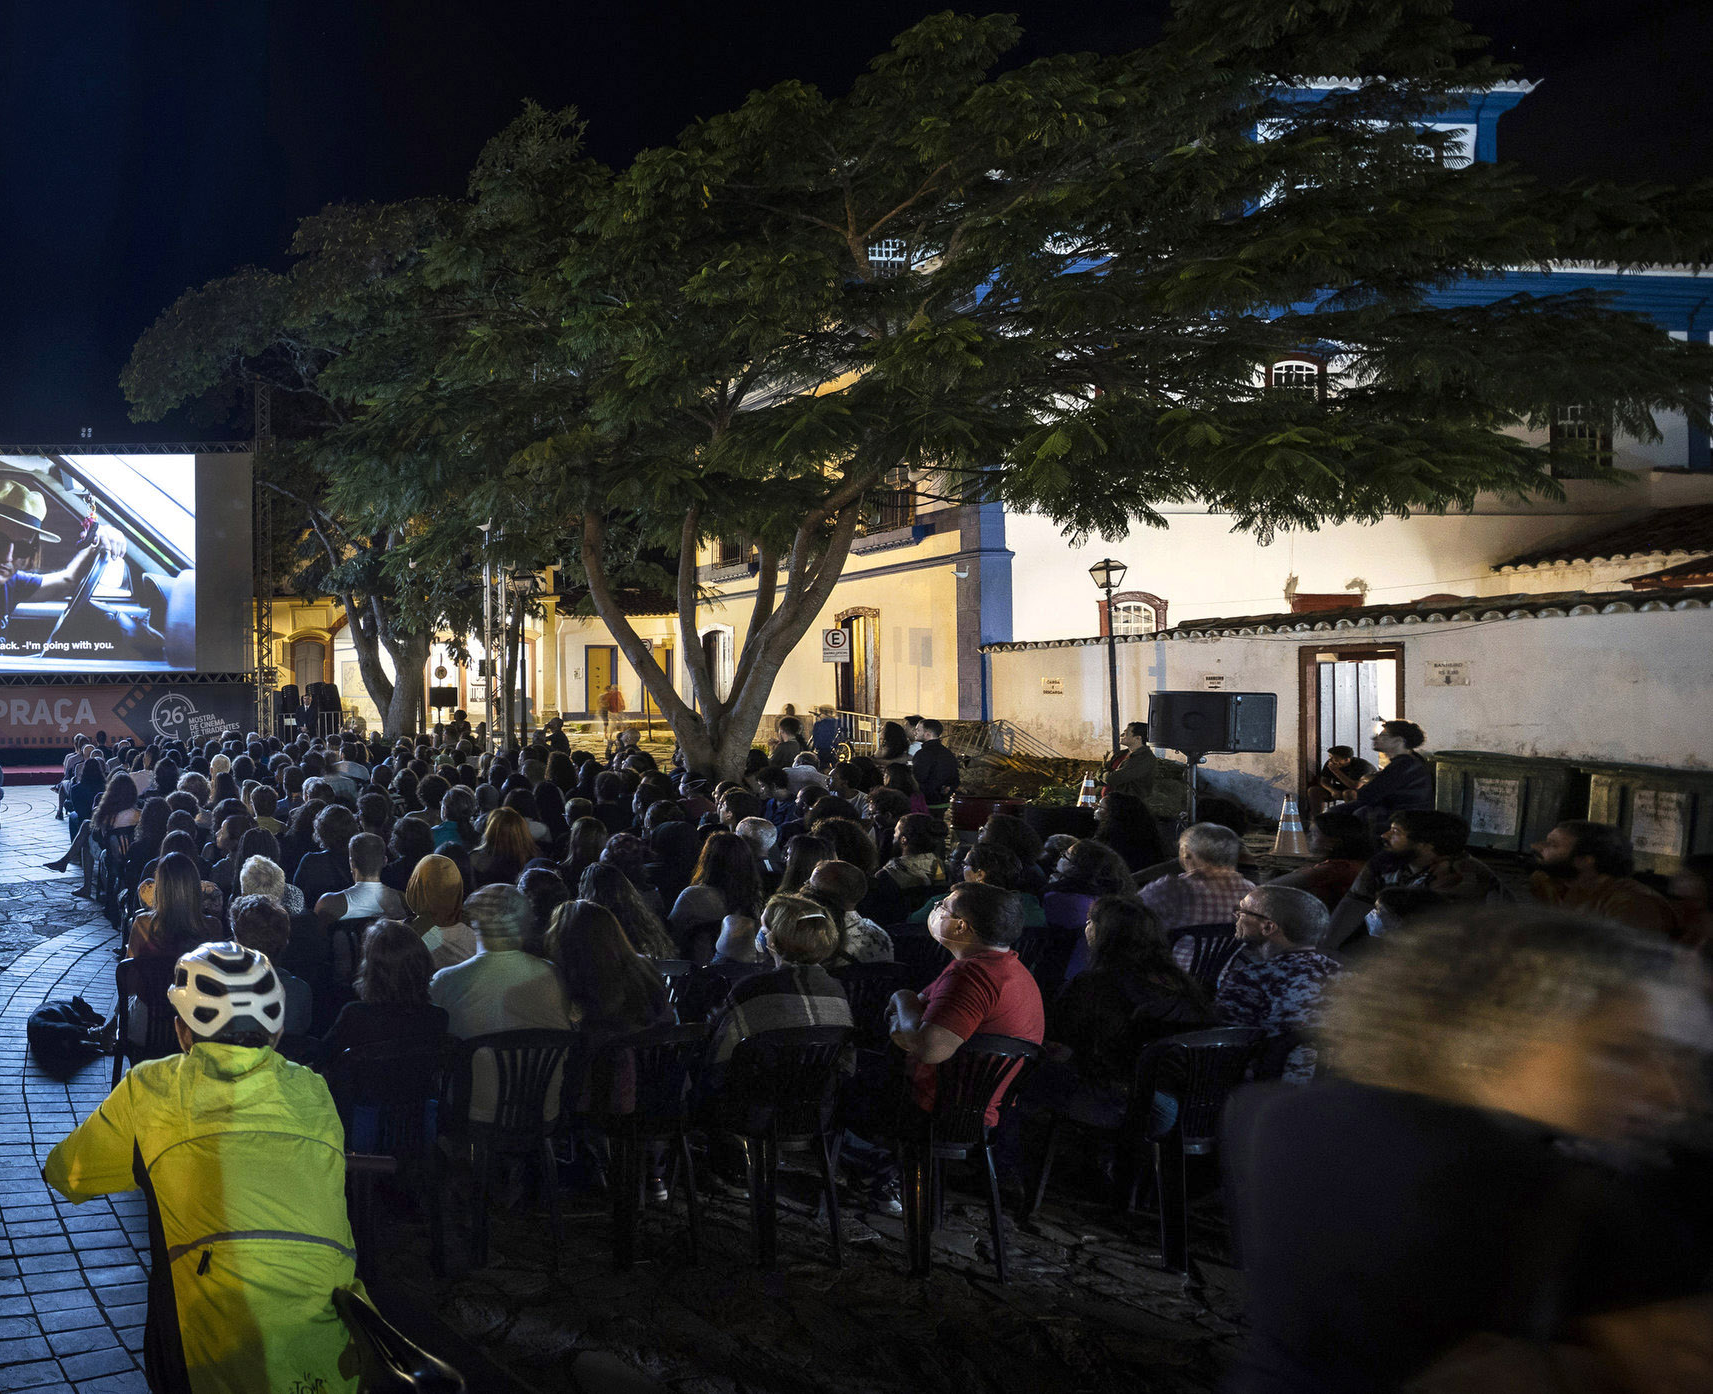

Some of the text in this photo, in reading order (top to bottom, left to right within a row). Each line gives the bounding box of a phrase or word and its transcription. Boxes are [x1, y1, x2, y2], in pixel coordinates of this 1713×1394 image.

[832, 633, 840, 645] E
[0, 641, 20, 651] back.
[22, 641, 41, 651] -I'm
[43, 641, 69, 652] going
[71, 641, 93, 651] with
[94, 643, 114, 652] you.
[189, 714, 216, 724] MOSTRA
[189, 718, 226, 731] DE CINEMA
[201, 722, 240, 736] TIRADENTES
